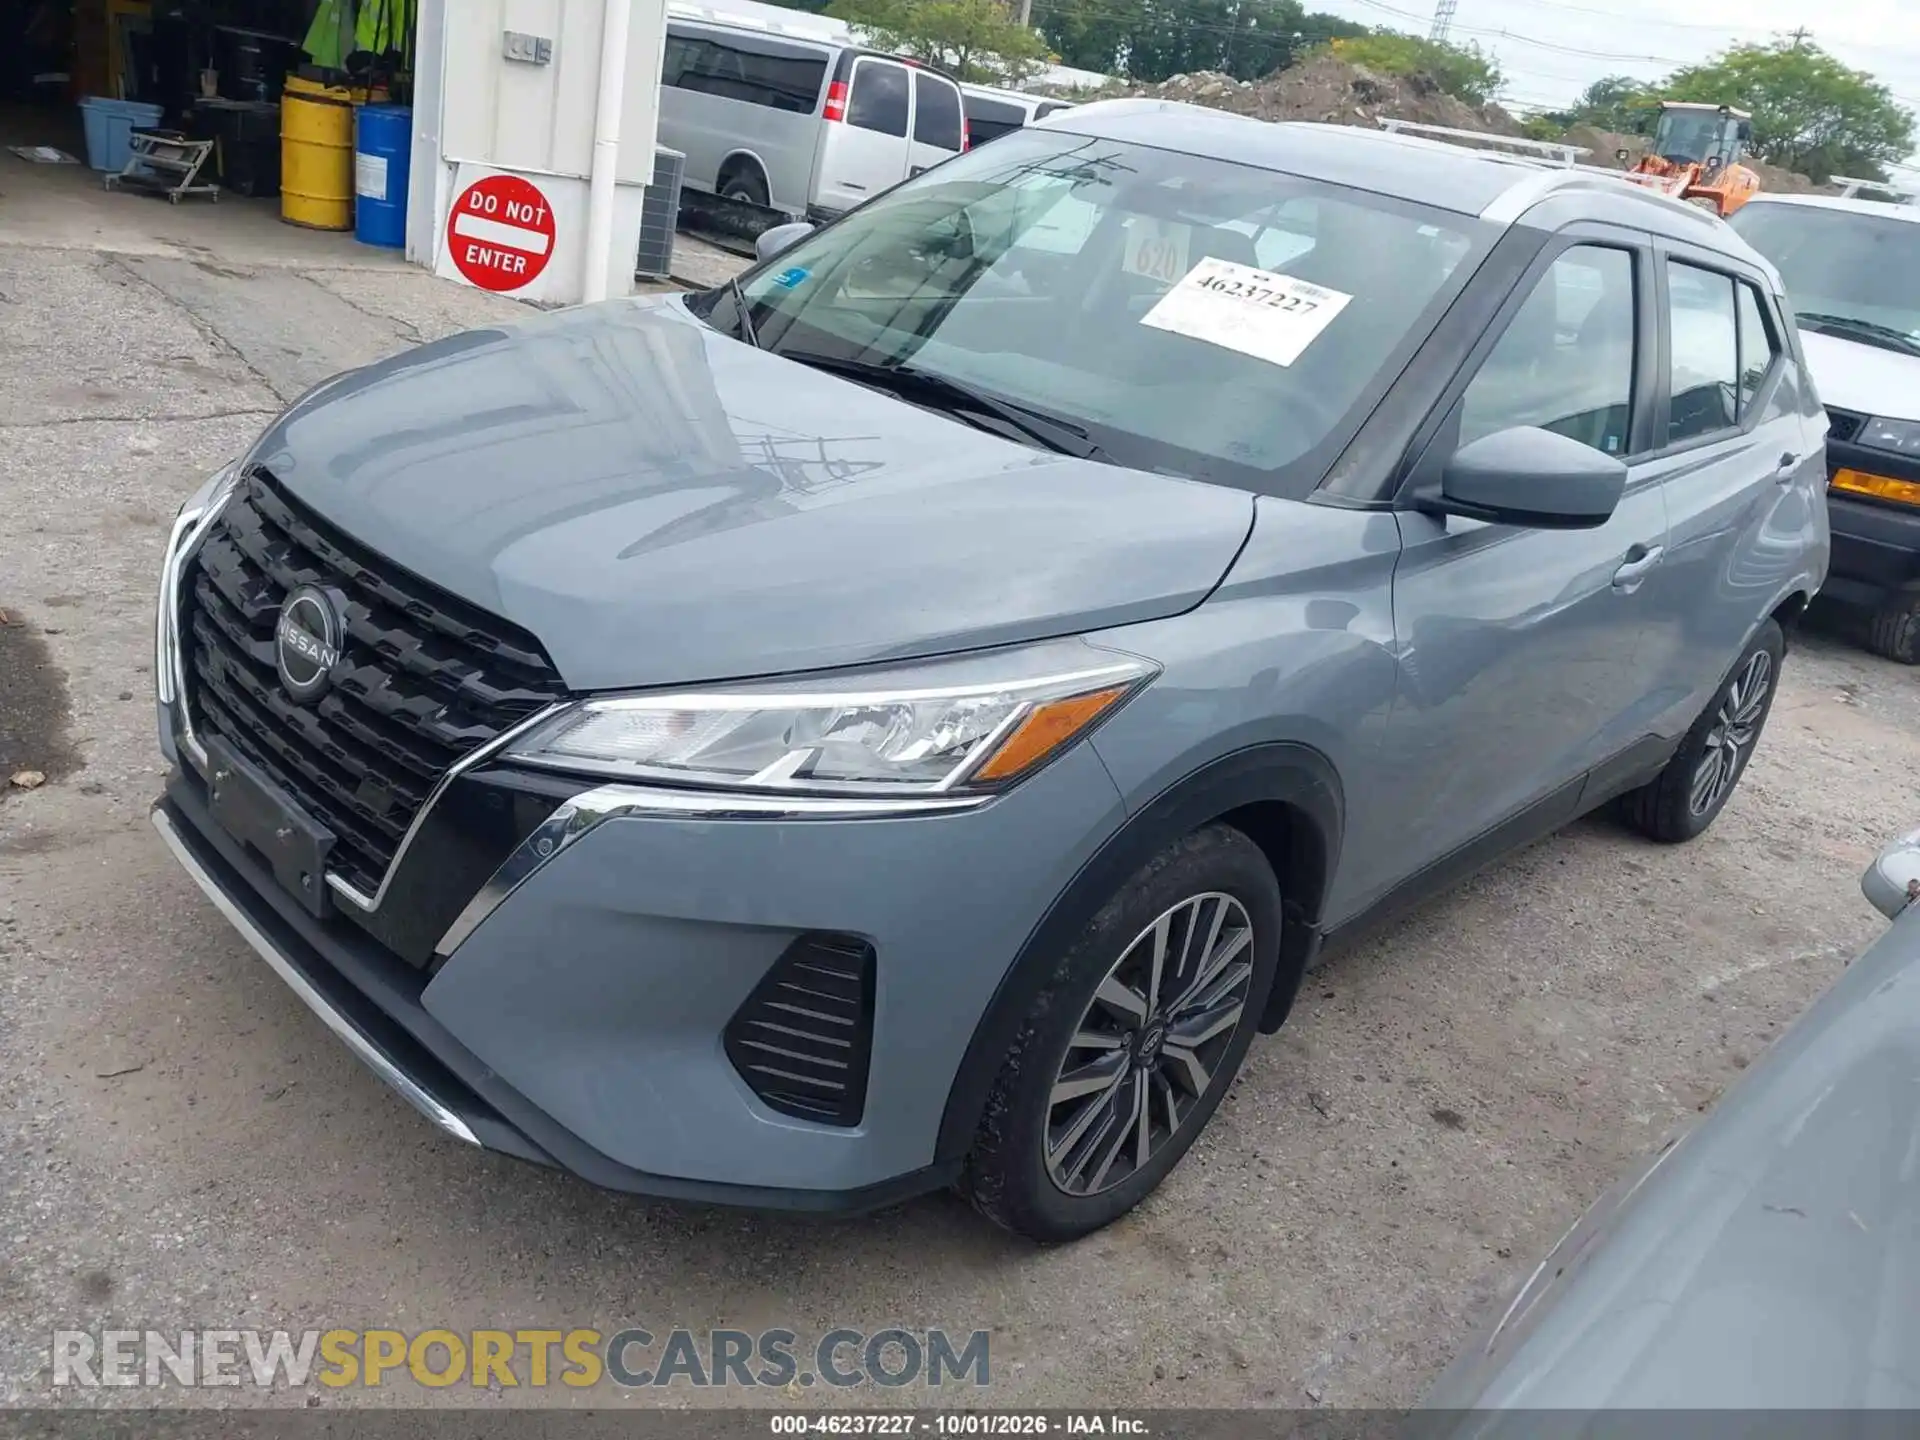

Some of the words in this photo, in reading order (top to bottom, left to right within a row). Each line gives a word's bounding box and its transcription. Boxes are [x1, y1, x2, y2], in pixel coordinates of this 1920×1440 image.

[470, 191, 497, 213] DO
[506, 200, 546, 226] NOT
[465, 244, 527, 274] ENTER
[1136, 237, 1178, 279] 620
[1196, 275, 1319, 314] 46237227
[279, 617, 335, 667] NISSAN
